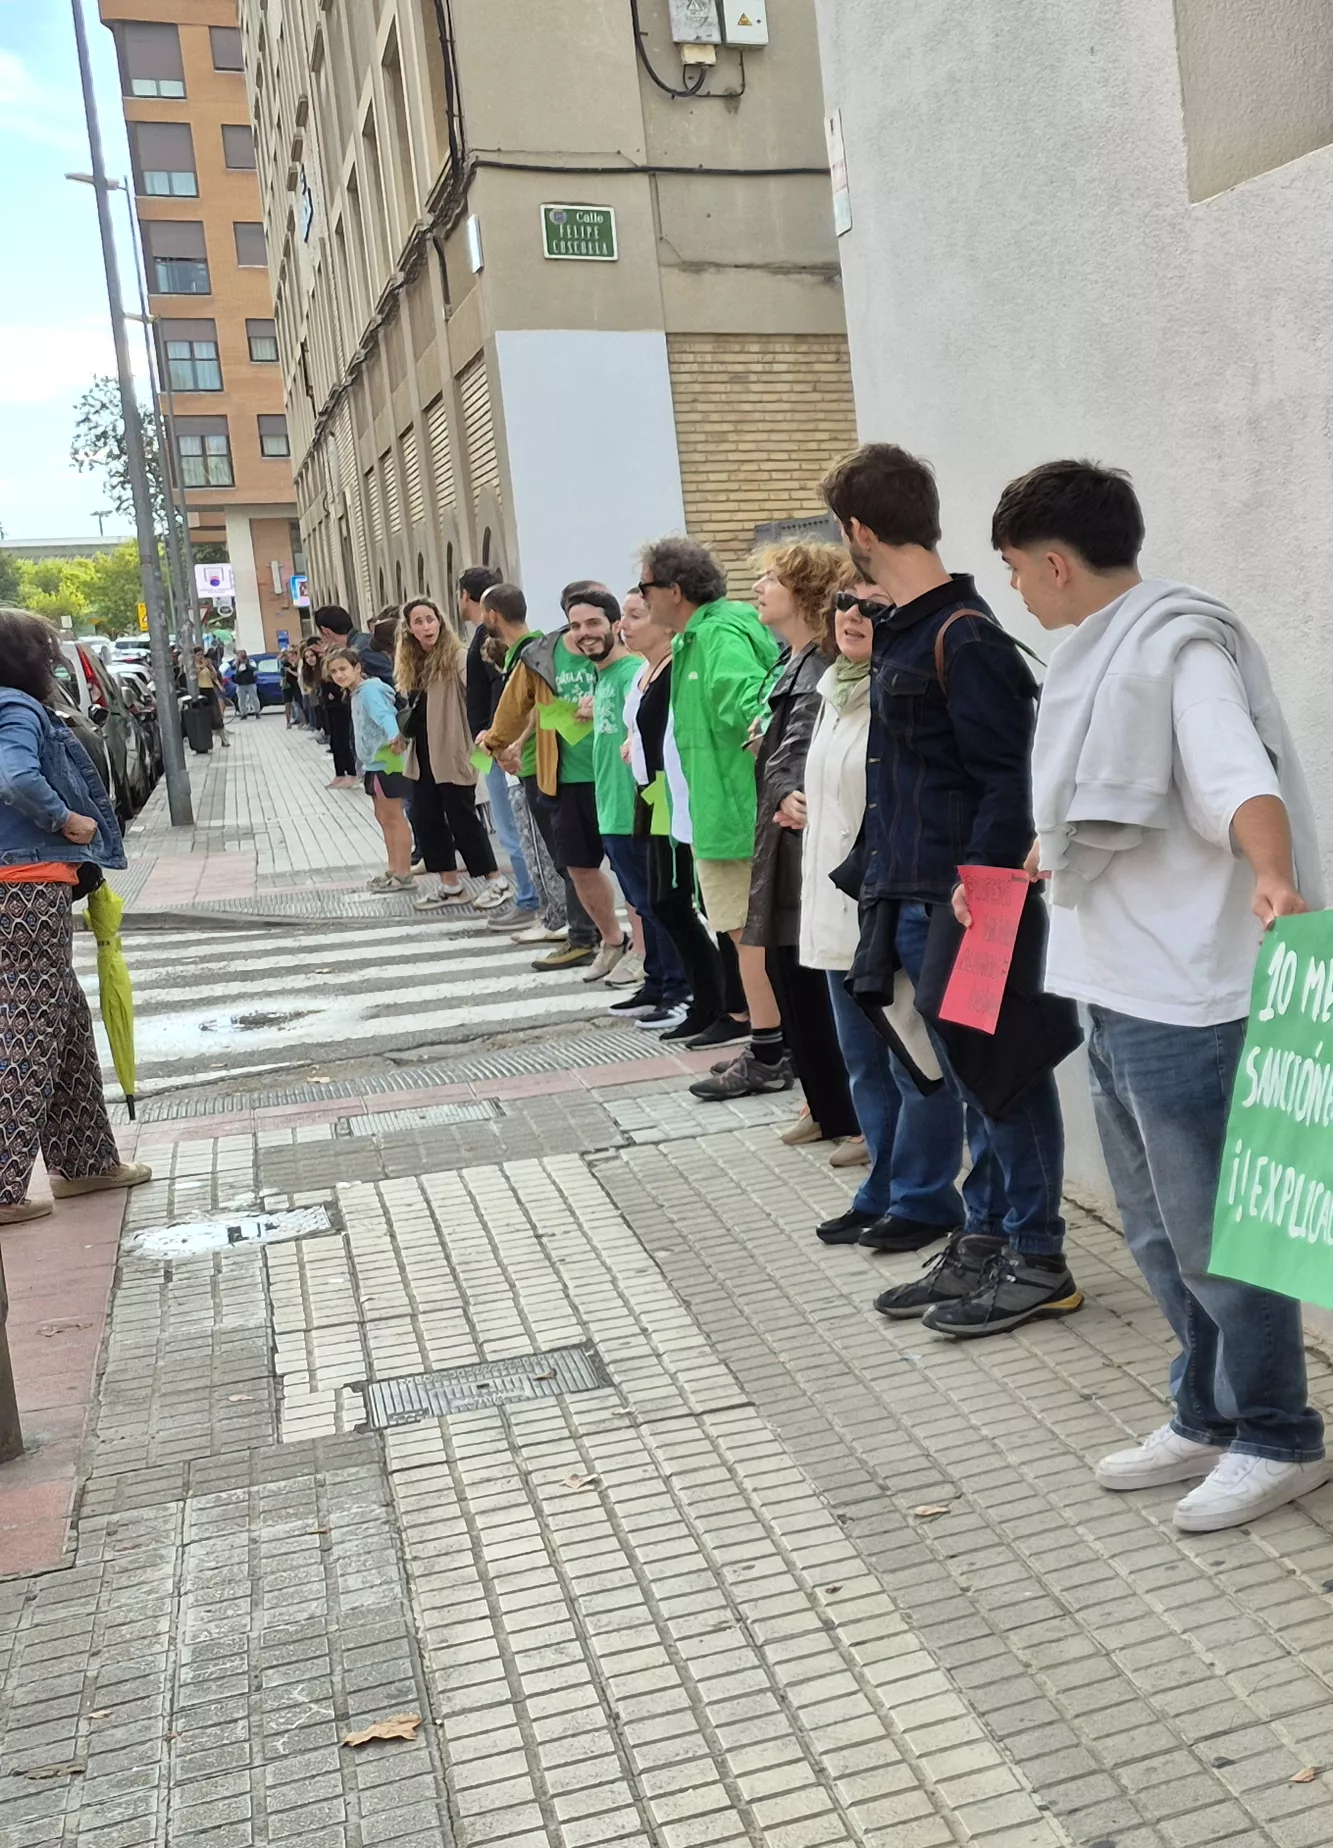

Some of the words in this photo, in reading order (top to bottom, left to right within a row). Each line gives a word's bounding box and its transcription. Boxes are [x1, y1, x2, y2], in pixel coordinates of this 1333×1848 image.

[576, 212, 604, 224] Calle
[560, 224, 600, 239] FELIPE
[553, 240, 608, 255] COSCOLLA
[1259, 941, 1298, 1021] 10
[1242, 1040, 1331, 1128] SANCIÓN
